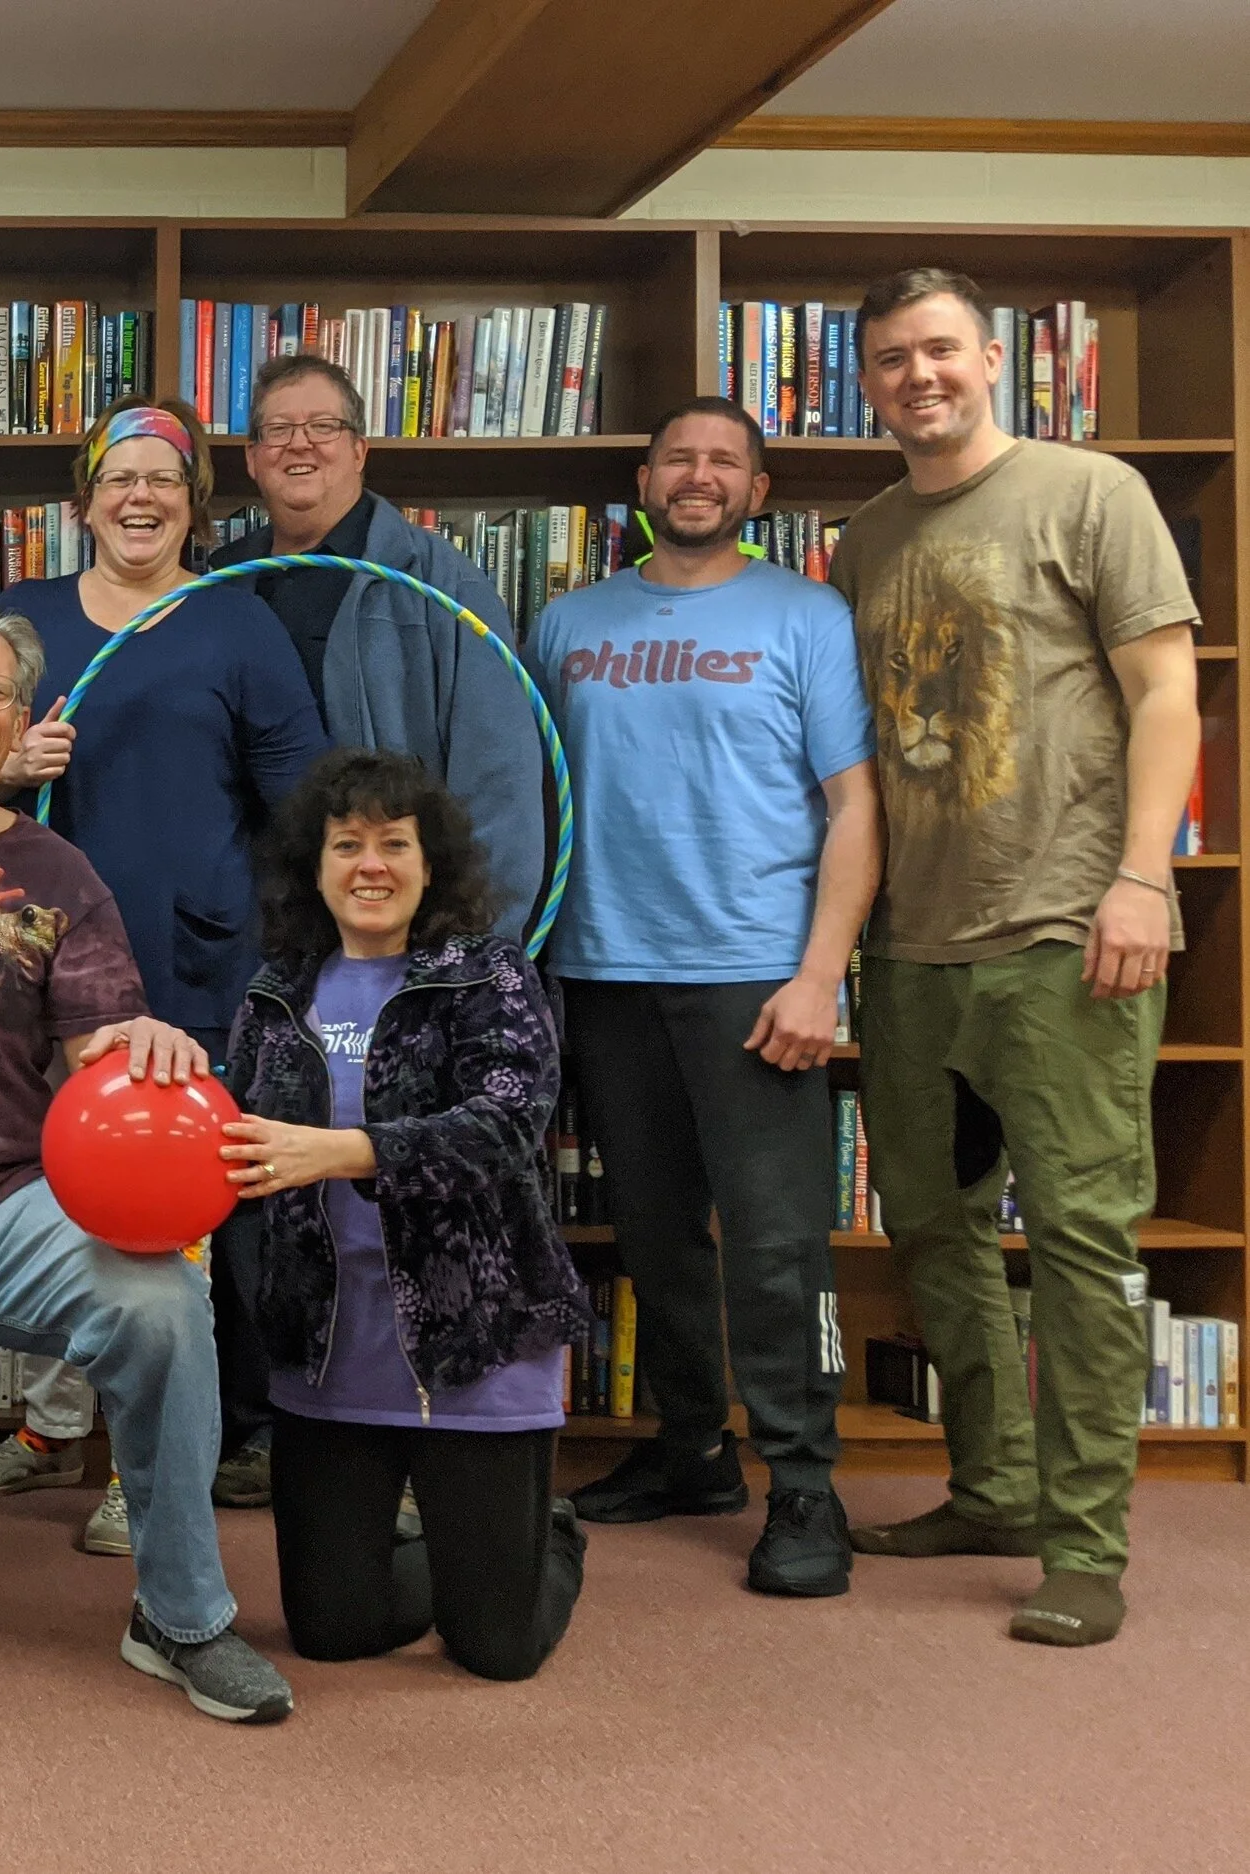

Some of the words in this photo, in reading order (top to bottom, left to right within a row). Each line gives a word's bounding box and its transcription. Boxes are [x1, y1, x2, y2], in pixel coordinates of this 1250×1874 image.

[38, 307, 49, 342] Griffin
[62, 307, 76, 346] Griffin
[594, 310, 603, 340] LUCKIEST
[766, 308, 777, 343] JAMES
[781, 312, 795, 336] JAMES
[829, 324, 838, 349] KILLER
[123, 331, 134, 347] Other
[122, 349, 134, 378] Landscape
[590, 357, 598, 377] ALIVE
[749, 363, 758, 377] ALEX
[782, 338, 796, 378] PATTERSON
[829, 350, 838, 369] VIEW
[767, 345, 777, 409] PATTERSON
[809, 343, 821, 407] PATTERSON
[38, 390, 47, 429] Warriors
[807, 412, 821, 423] 10
[8, 548, 16, 583] HARRIS
[560, 638, 764, 708] phillies
[850, 949, 862, 975] STEEL
[321, 1021, 358, 1032] OUNTY
[840, 1099, 855, 1138] Beautiful
[841, 1140, 855, 1166] Ruins
[856, 1157, 867, 1195] LIVING
[841, 1187, 851, 1212] Walter
